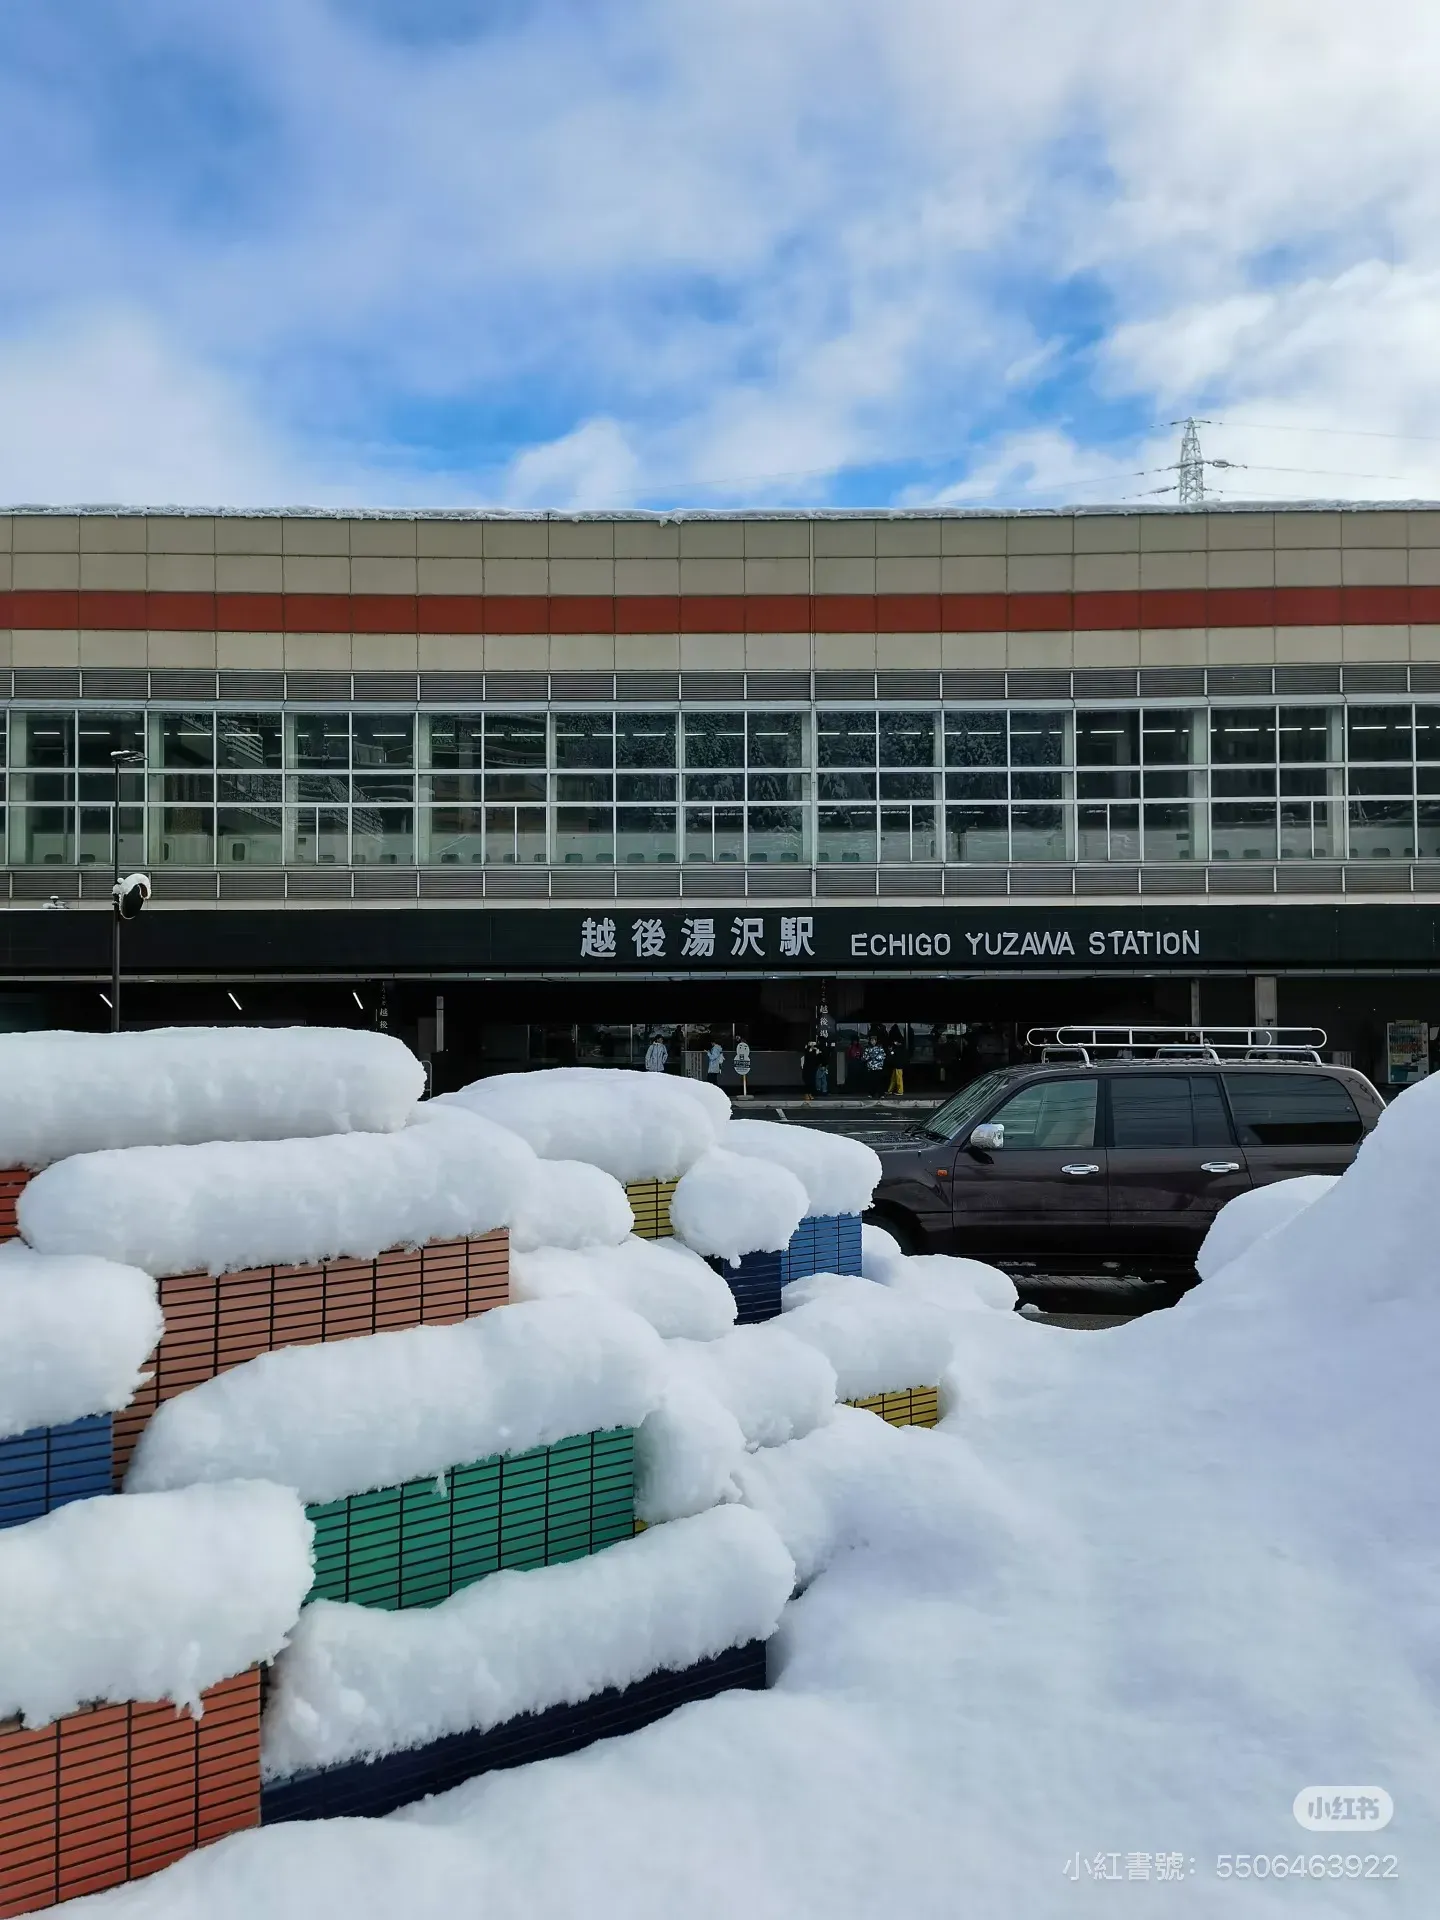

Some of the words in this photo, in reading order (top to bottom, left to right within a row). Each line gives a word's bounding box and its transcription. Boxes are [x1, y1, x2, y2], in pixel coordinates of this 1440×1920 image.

[580, 917, 815, 957] 越後湯沢駅
[851, 932, 951, 956] ECHIGO
[965, 931, 1075, 956] YUZAWA
[1089, 930, 1201, 955] STATION
